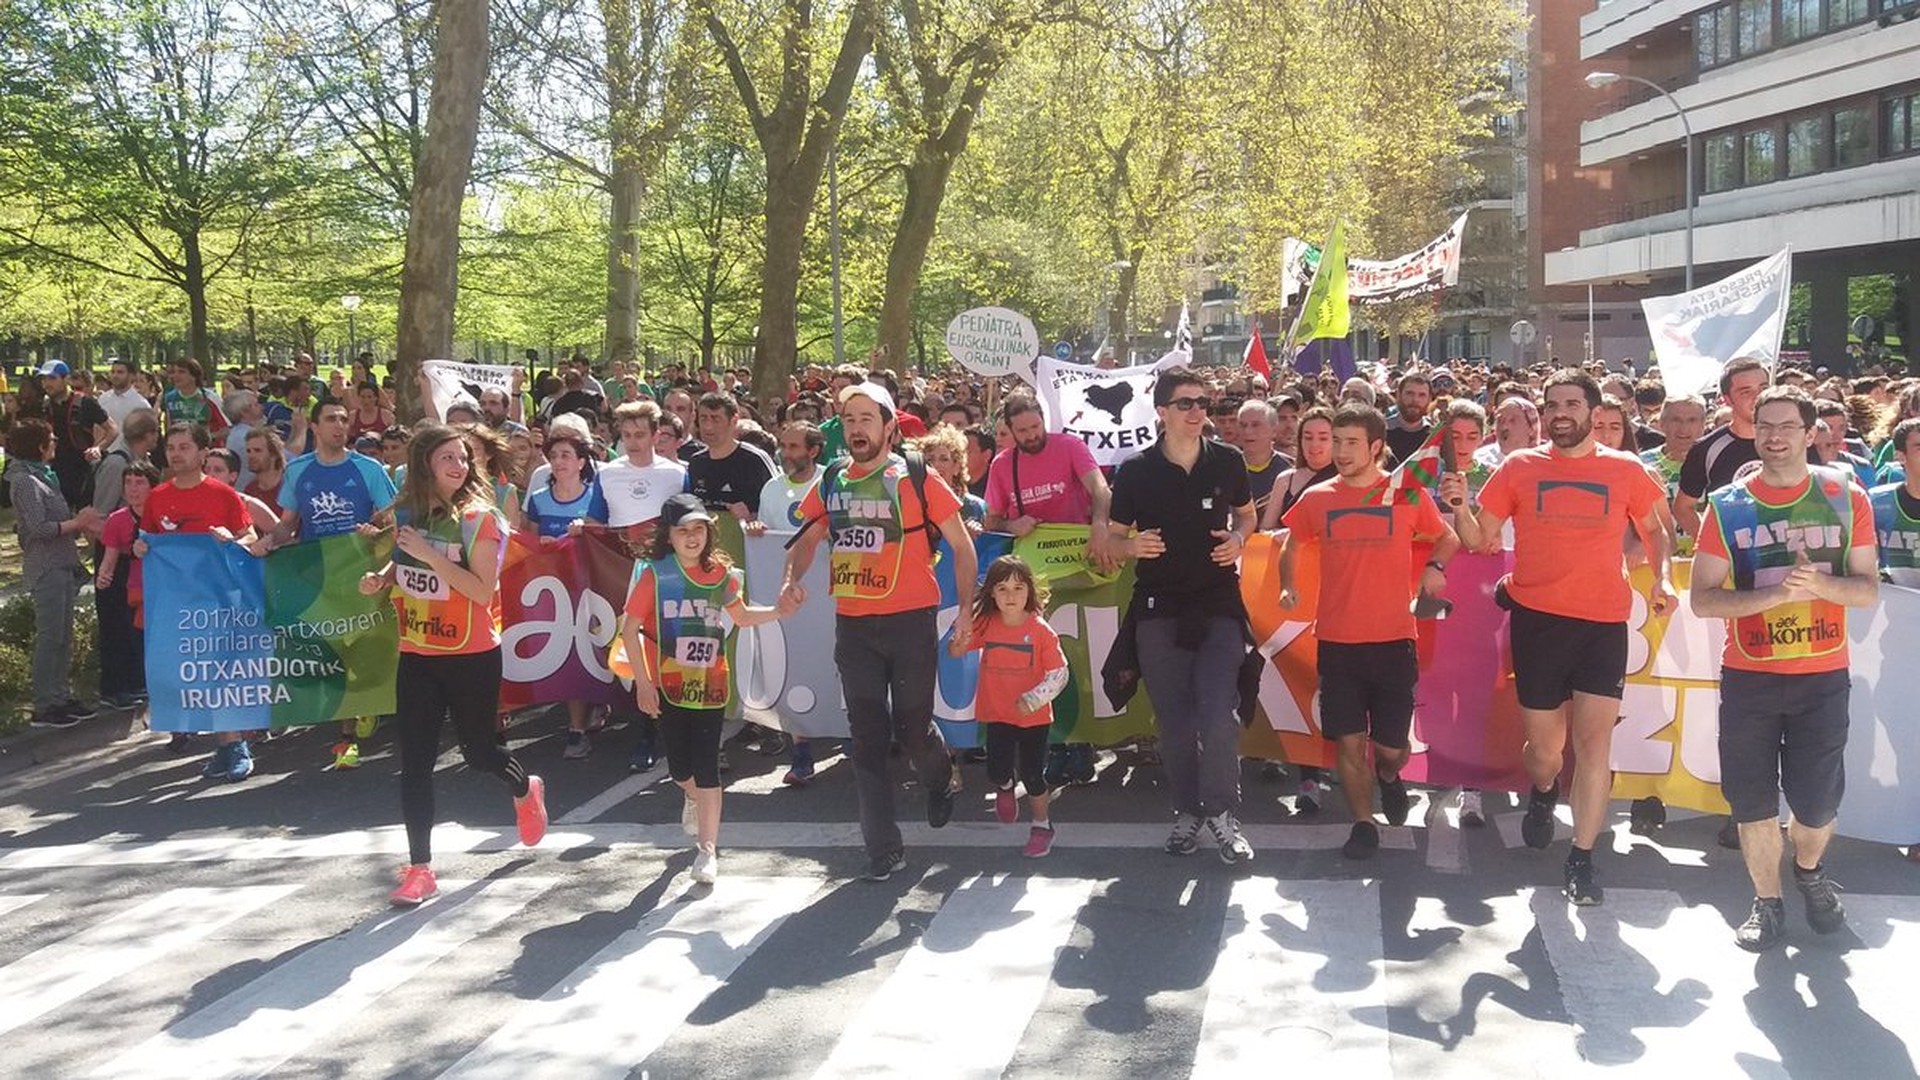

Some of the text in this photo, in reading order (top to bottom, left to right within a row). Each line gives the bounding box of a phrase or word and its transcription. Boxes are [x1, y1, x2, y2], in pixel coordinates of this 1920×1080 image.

[1062, 422, 1157, 449] TXER
[827, 491, 892, 519] ATZUK
[1734, 519, 1842, 553] BATZUK
[178, 607, 385, 639] 2017ko artxoaren
[501, 575, 620, 684] ae
[1767, 619, 1840, 646] korrika
[178, 633, 286, 658] apirilaren
[179, 657, 345, 682] OTXANDIOTIK
[180, 683, 292, 708] IRUÑERA
